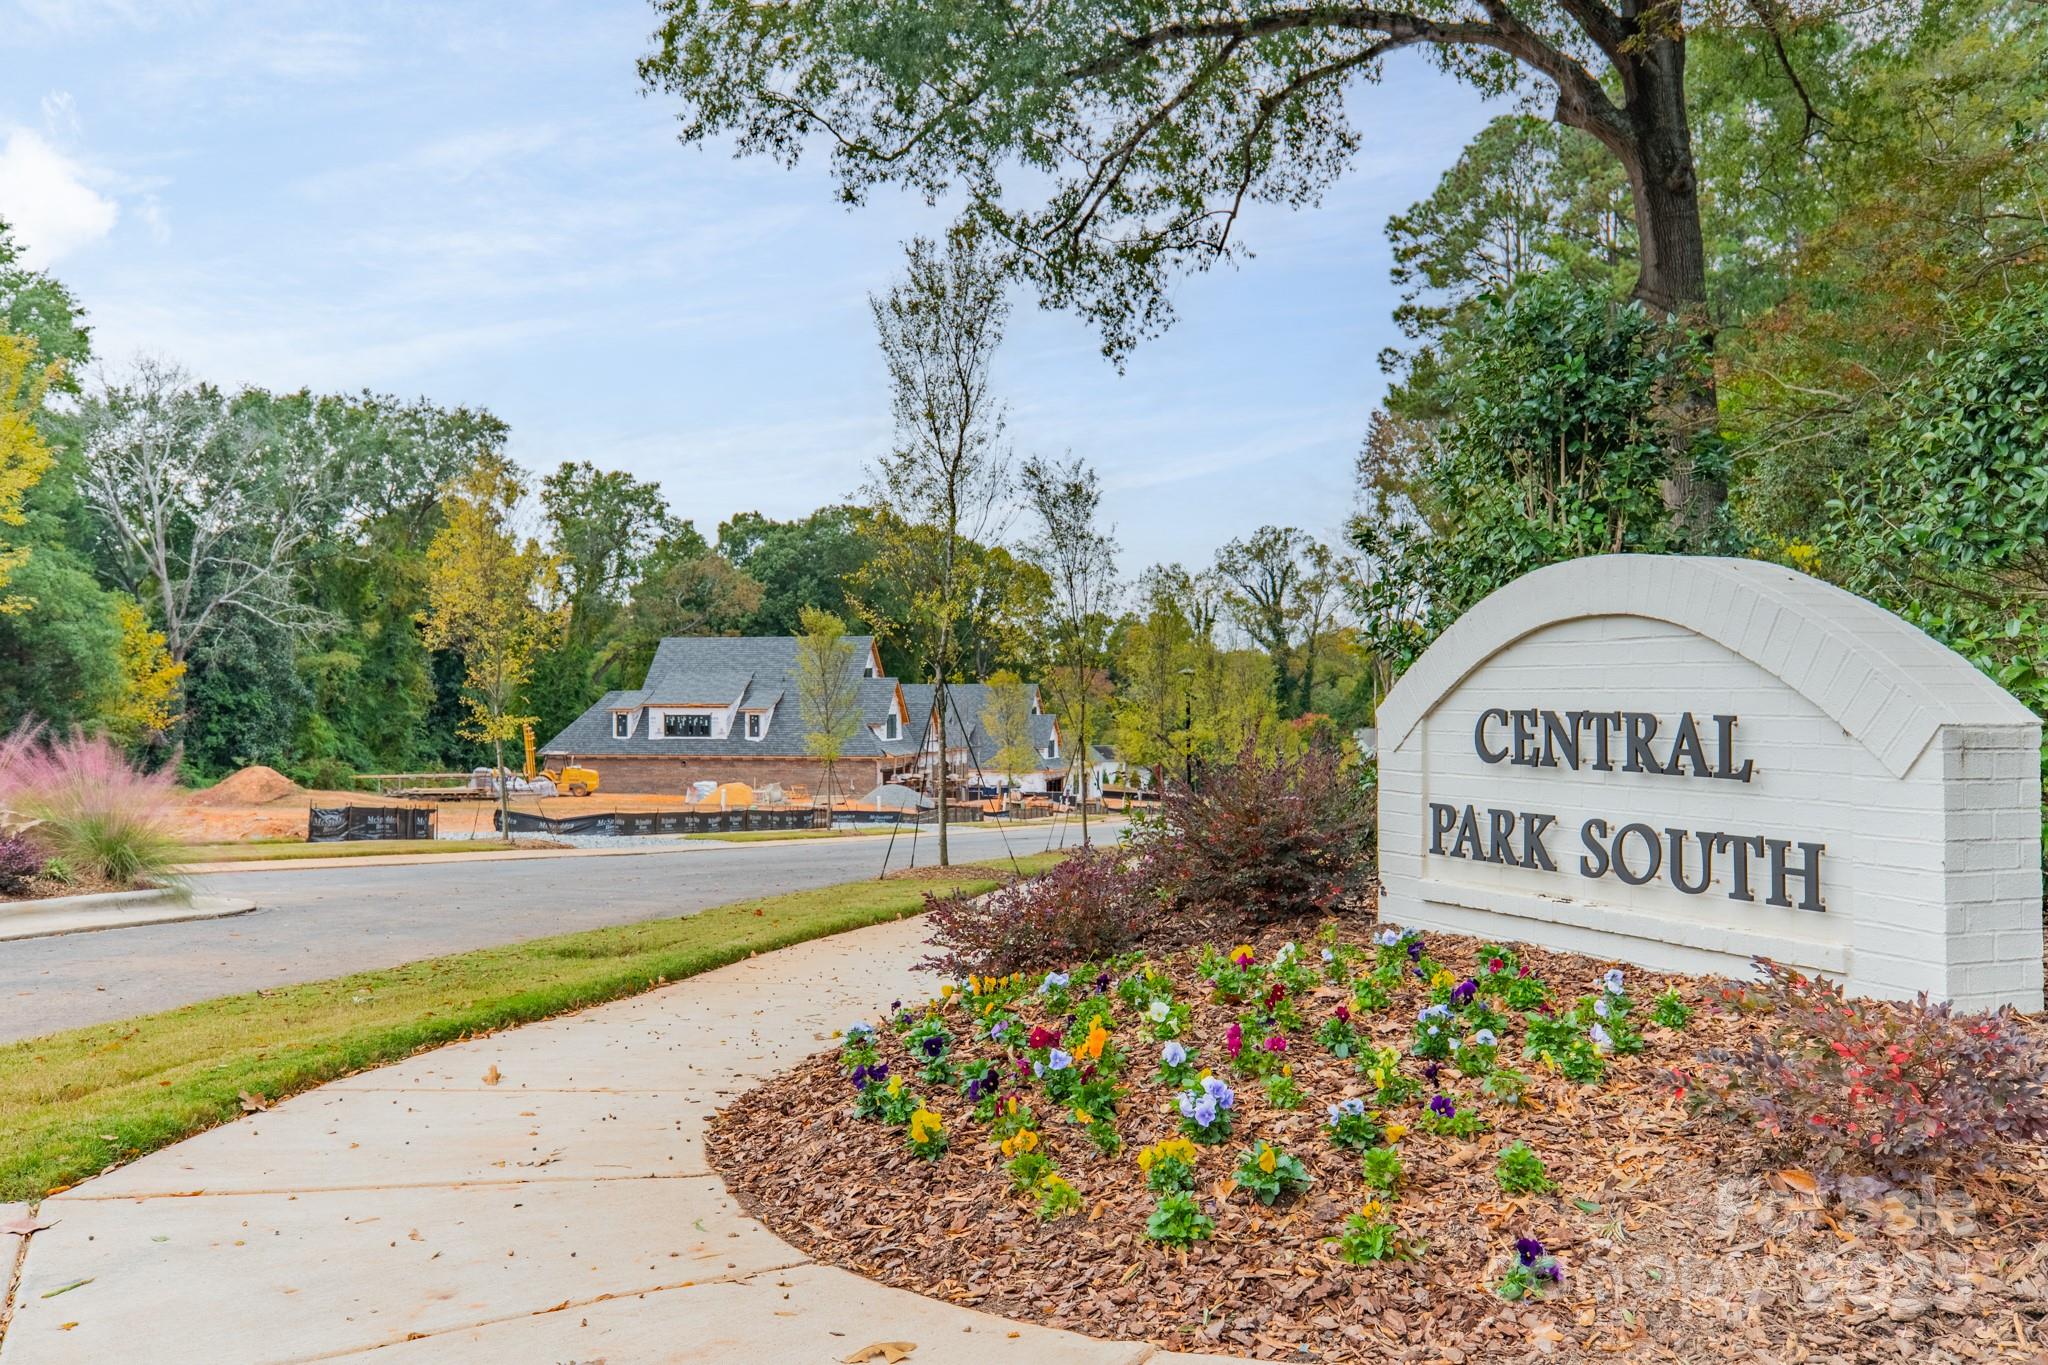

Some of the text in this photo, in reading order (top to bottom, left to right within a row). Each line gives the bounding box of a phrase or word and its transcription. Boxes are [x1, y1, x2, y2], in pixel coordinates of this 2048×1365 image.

[1474, 707, 1754, 783] CENTRAL
[1429, 802, 1826, 913] PARK SOUTH
